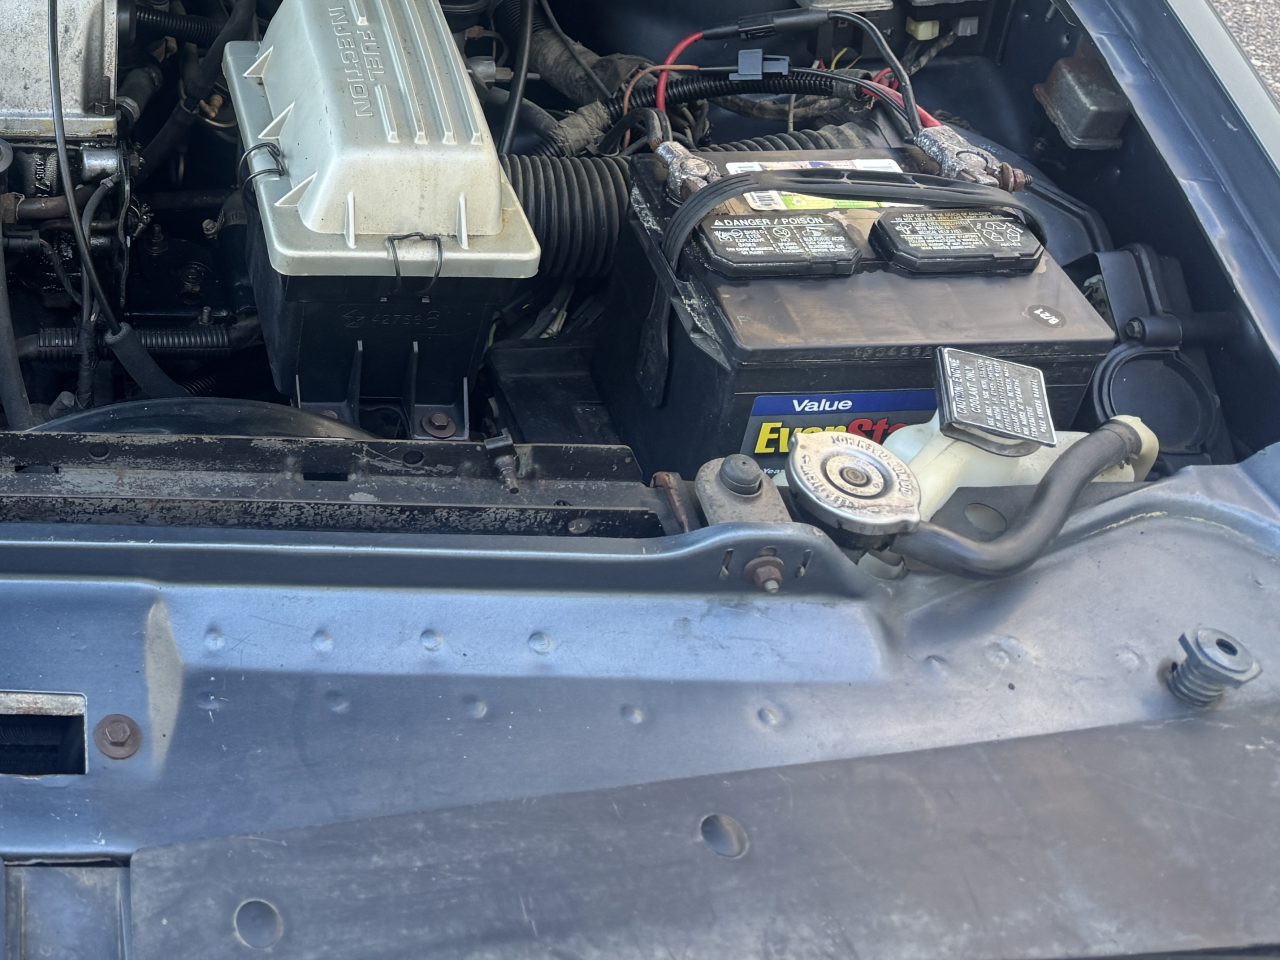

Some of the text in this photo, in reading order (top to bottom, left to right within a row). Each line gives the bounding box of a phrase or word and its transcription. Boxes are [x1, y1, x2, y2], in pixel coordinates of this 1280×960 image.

[328, 6, 373, 118] INJECTION
[357, 29, 385, 82] FUEL
[950, 357, 962, 382] ENGINE
[792, 398, 853, 412] Value
[968, 381, 981, 413] COOLANT
